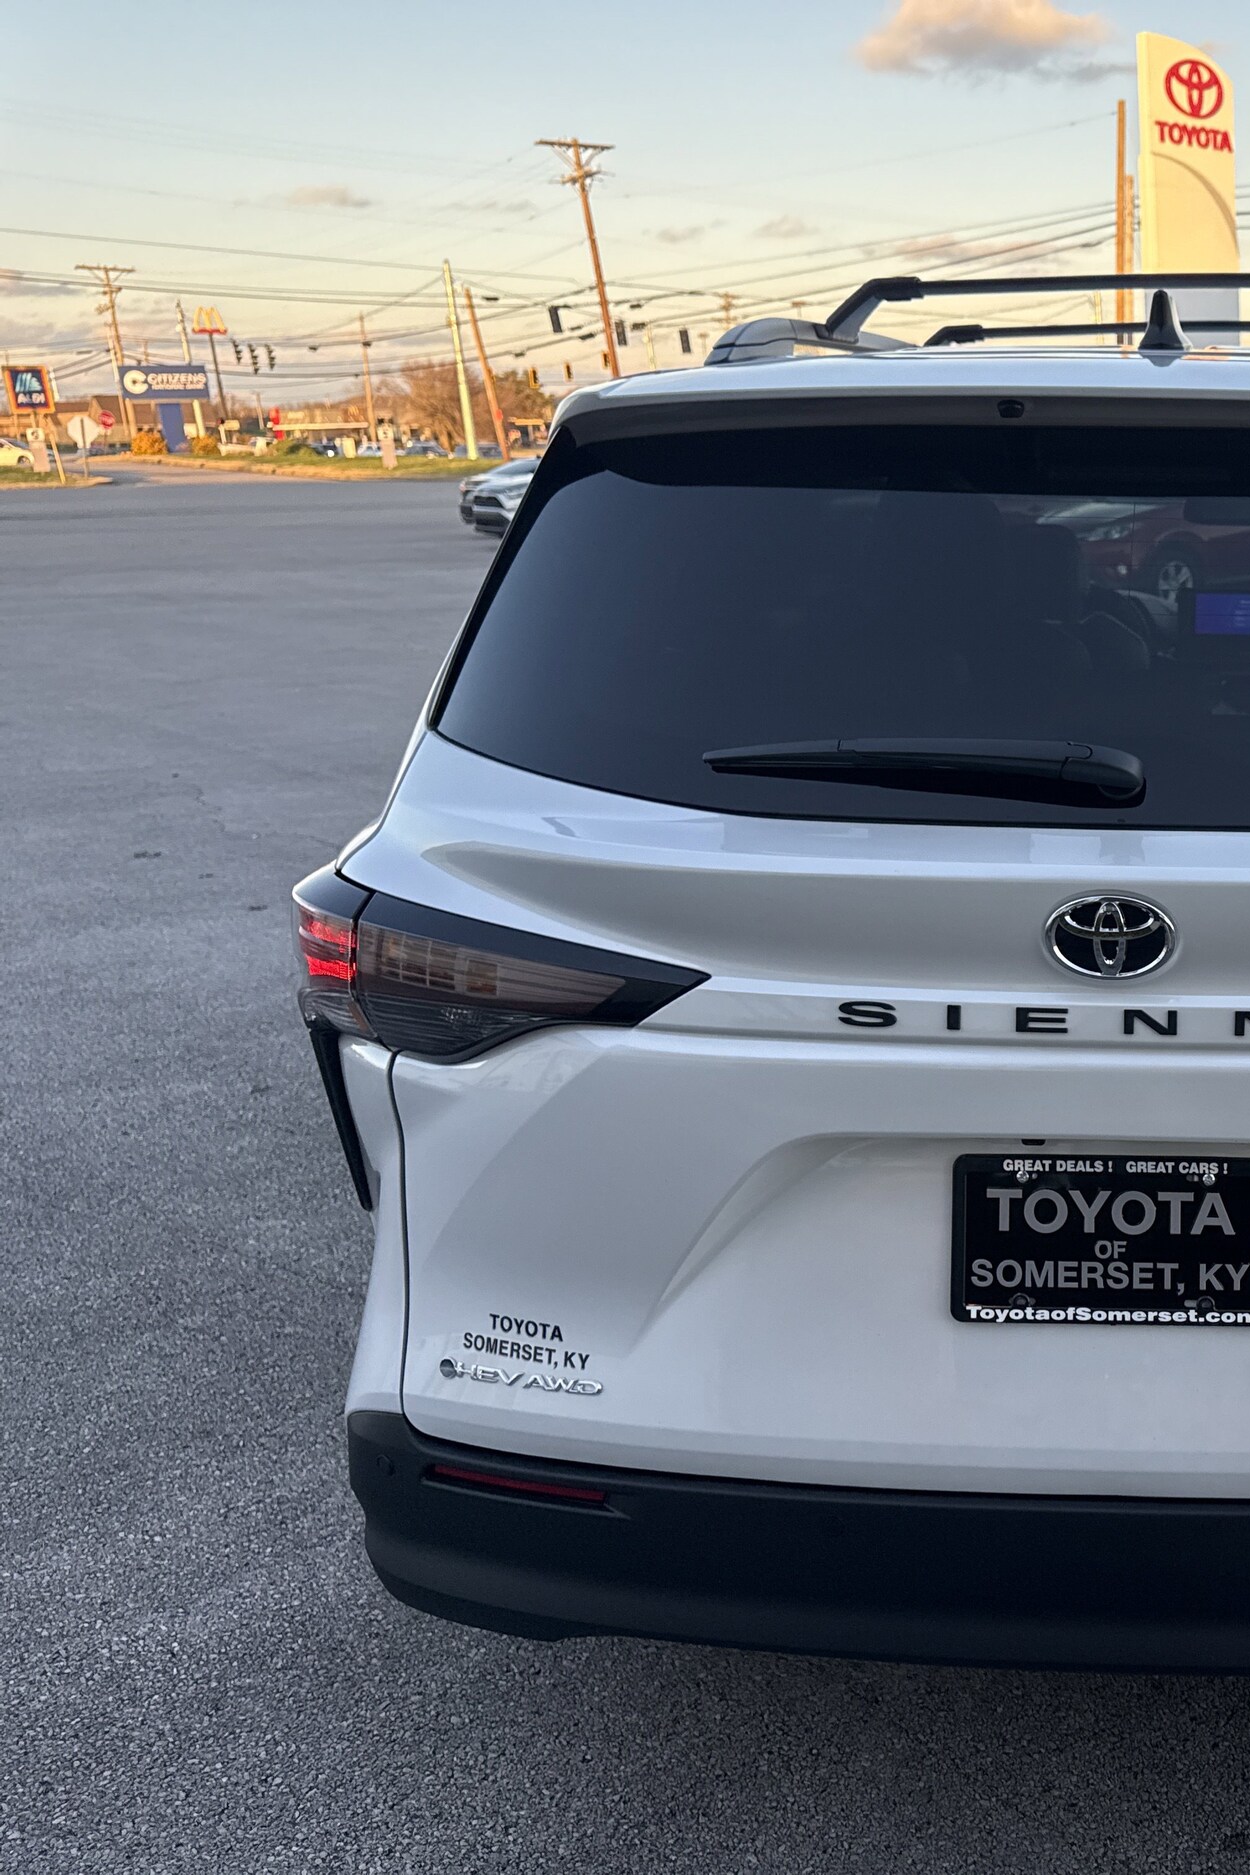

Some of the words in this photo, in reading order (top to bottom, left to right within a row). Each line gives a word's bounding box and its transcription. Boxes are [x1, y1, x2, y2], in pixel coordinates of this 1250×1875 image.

[1155, 120, 1234, 153] TOYOTA
[147, 372, 207, 385] CITIZENS
[1002, 1158, 1052, 1172] GREAT
[1125, 1160, 1175, 1174] GREAT
[985, 1187, 1236, 1236] TOYOTA
[1094, 1239, 1127, 1259] OF
[970, 1258, 1186, 1296] SOMERSET,
[1199, 1262, 1250, 1292] KY
[489, 1313, 564, 1342] TOYOTA
[463, 1332, 559, 1369] SOMERSET,
[563, 1350, 590, 1370] KY
[457, 1361, 525, 1386] HEV
[523, 1373, 604, 1395] AWD
